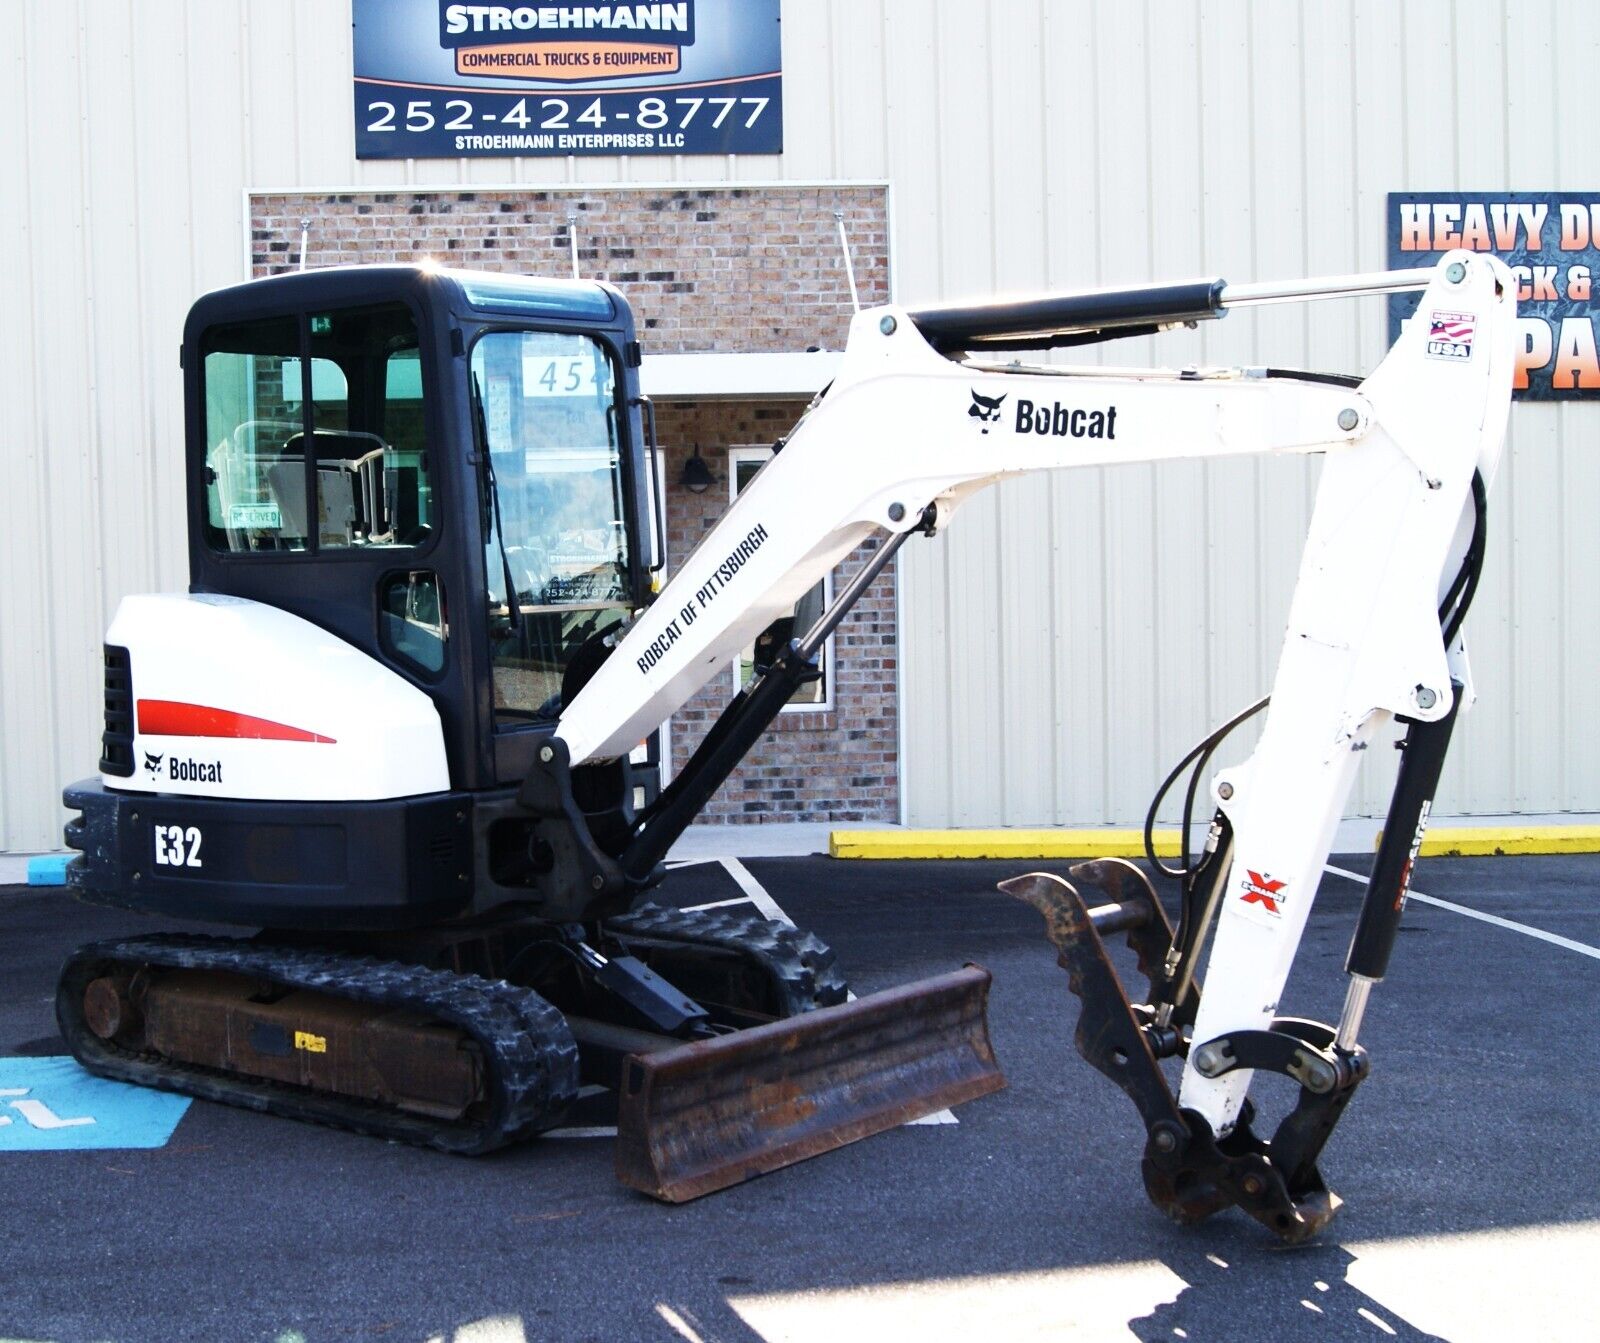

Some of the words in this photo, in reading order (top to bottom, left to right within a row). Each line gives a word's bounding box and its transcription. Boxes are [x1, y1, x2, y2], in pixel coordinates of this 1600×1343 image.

[446, 3, 688, 34] STROEHMANN
[462, 53, 541, 67] COMMERCIAL
[543, 52, 589, 66] TRUCKS
[593, 52, 601, 65] &
[604, 51, 673, 65] EQUIPMENT
[367, 97, 770, 132] 252-424-8777
[455, 134, 553, 150] STROEHMANN
[558, 134, 655, 148] ENTERPRISES
[658, 133, 685, 147] LLC
[1400, 203, 1548, 251] HEAVY
[1567, 265, 1591, 300] &
[1428, 342, 1471, 358] USA
[1015, 399, 1117, 440] Bobcat
[637, 620, 684, 675] BOBCAT
[680, 601, 699, 626] OF
[695, 523, 769, 608] PITTSBURGH
[169, 757, 222, 783] Bobcat
[155, 825, 202, 867] E32
